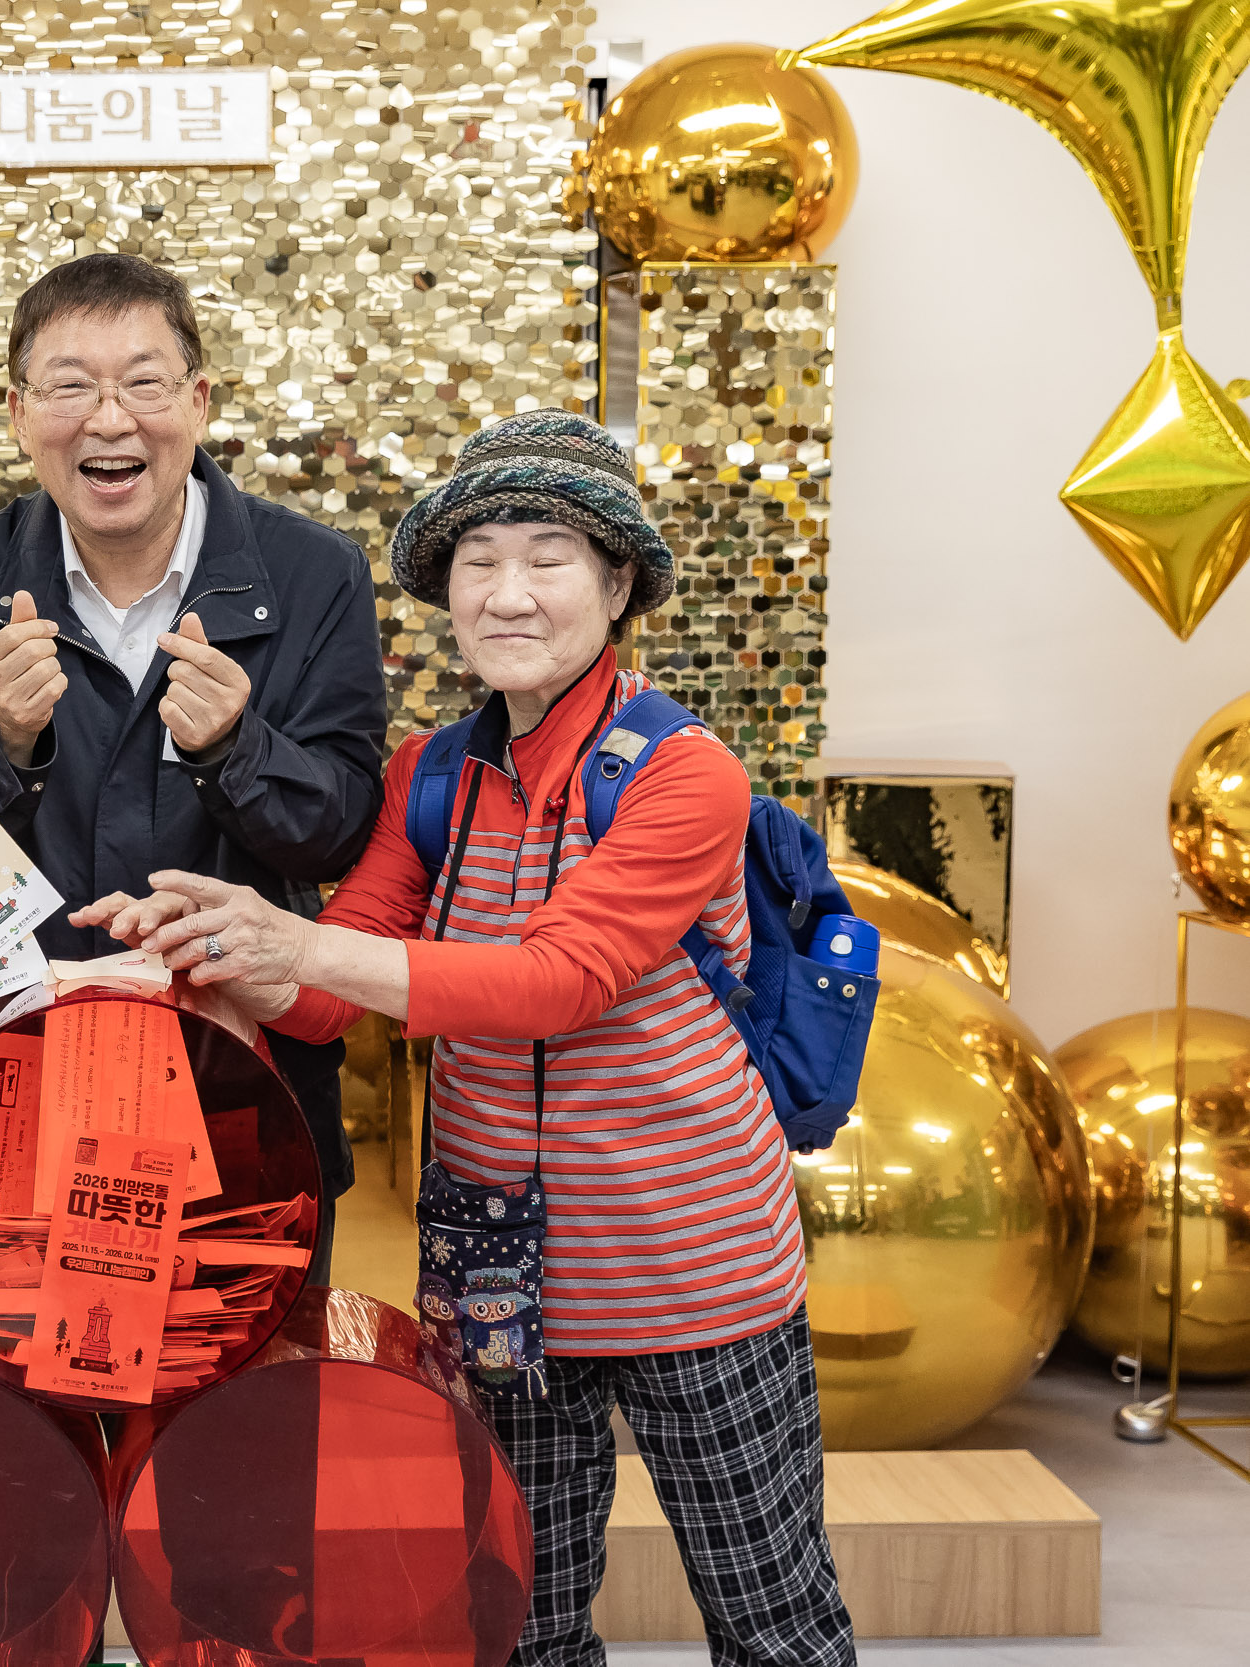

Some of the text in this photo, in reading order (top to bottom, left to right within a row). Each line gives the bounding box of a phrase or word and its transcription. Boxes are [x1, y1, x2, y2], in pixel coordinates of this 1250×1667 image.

[174, 86, 229, 142] 날
[73, 1173, 108, 1189] 2026
[112, 1178, 169, 1200] 희망온돌
[67, 1189, 167, 1229] 따뜻한
[64, 1220, 160, 1252] 겨울나기
[66, 1258, 103, 1273] 우리동네
